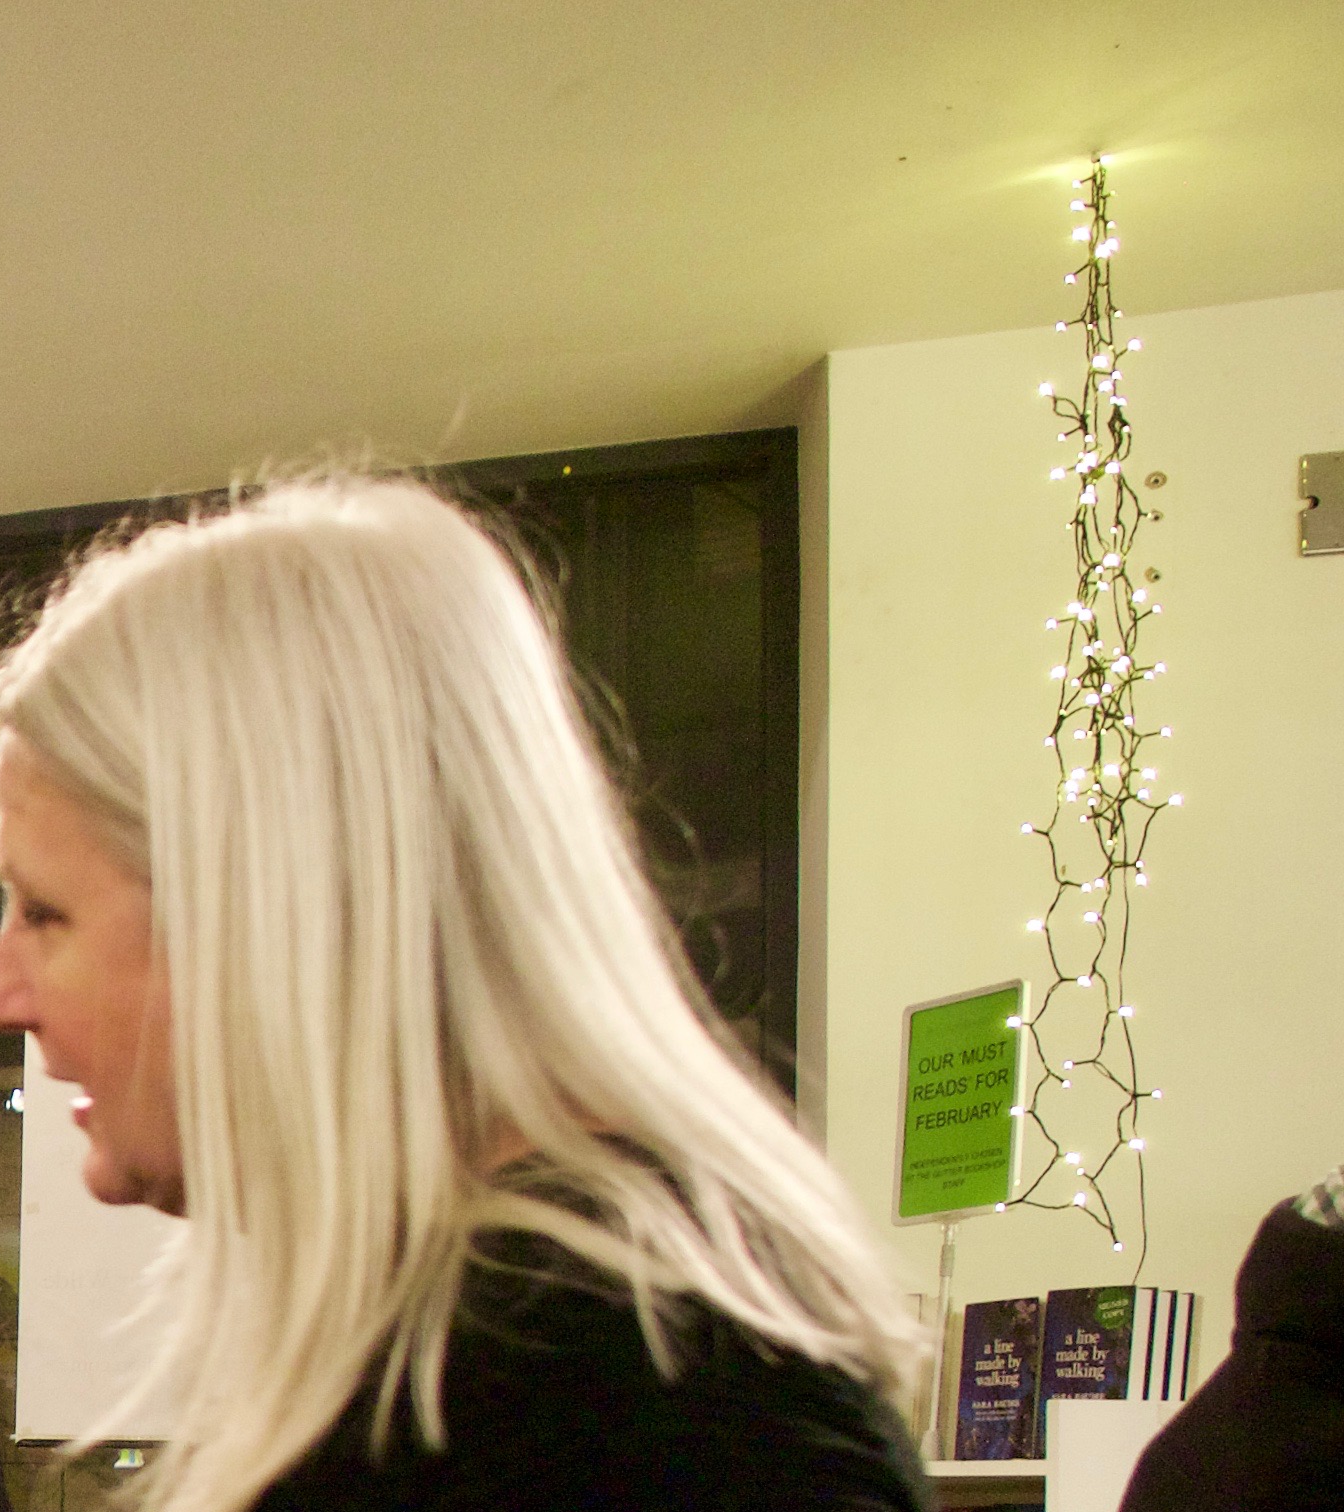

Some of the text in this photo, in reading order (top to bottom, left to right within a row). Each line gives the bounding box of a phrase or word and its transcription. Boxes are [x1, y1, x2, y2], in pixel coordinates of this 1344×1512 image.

[918, 1053, 953, 1074] OUR
[975, 1068, 1009, 1090] FOR
[915, 1100, 1003, 1131] FEBRUARY
[1065, 1328, 1100, 1345] a line
[984, 1338, 1015, 1354] a line
[1056, 1346, 1109, 1364] made by
[975, 1354, 1022, 1372] made by
[1056, 1363, 1105, 1381] walking
[975, 1371, 1020, 1388] walking
